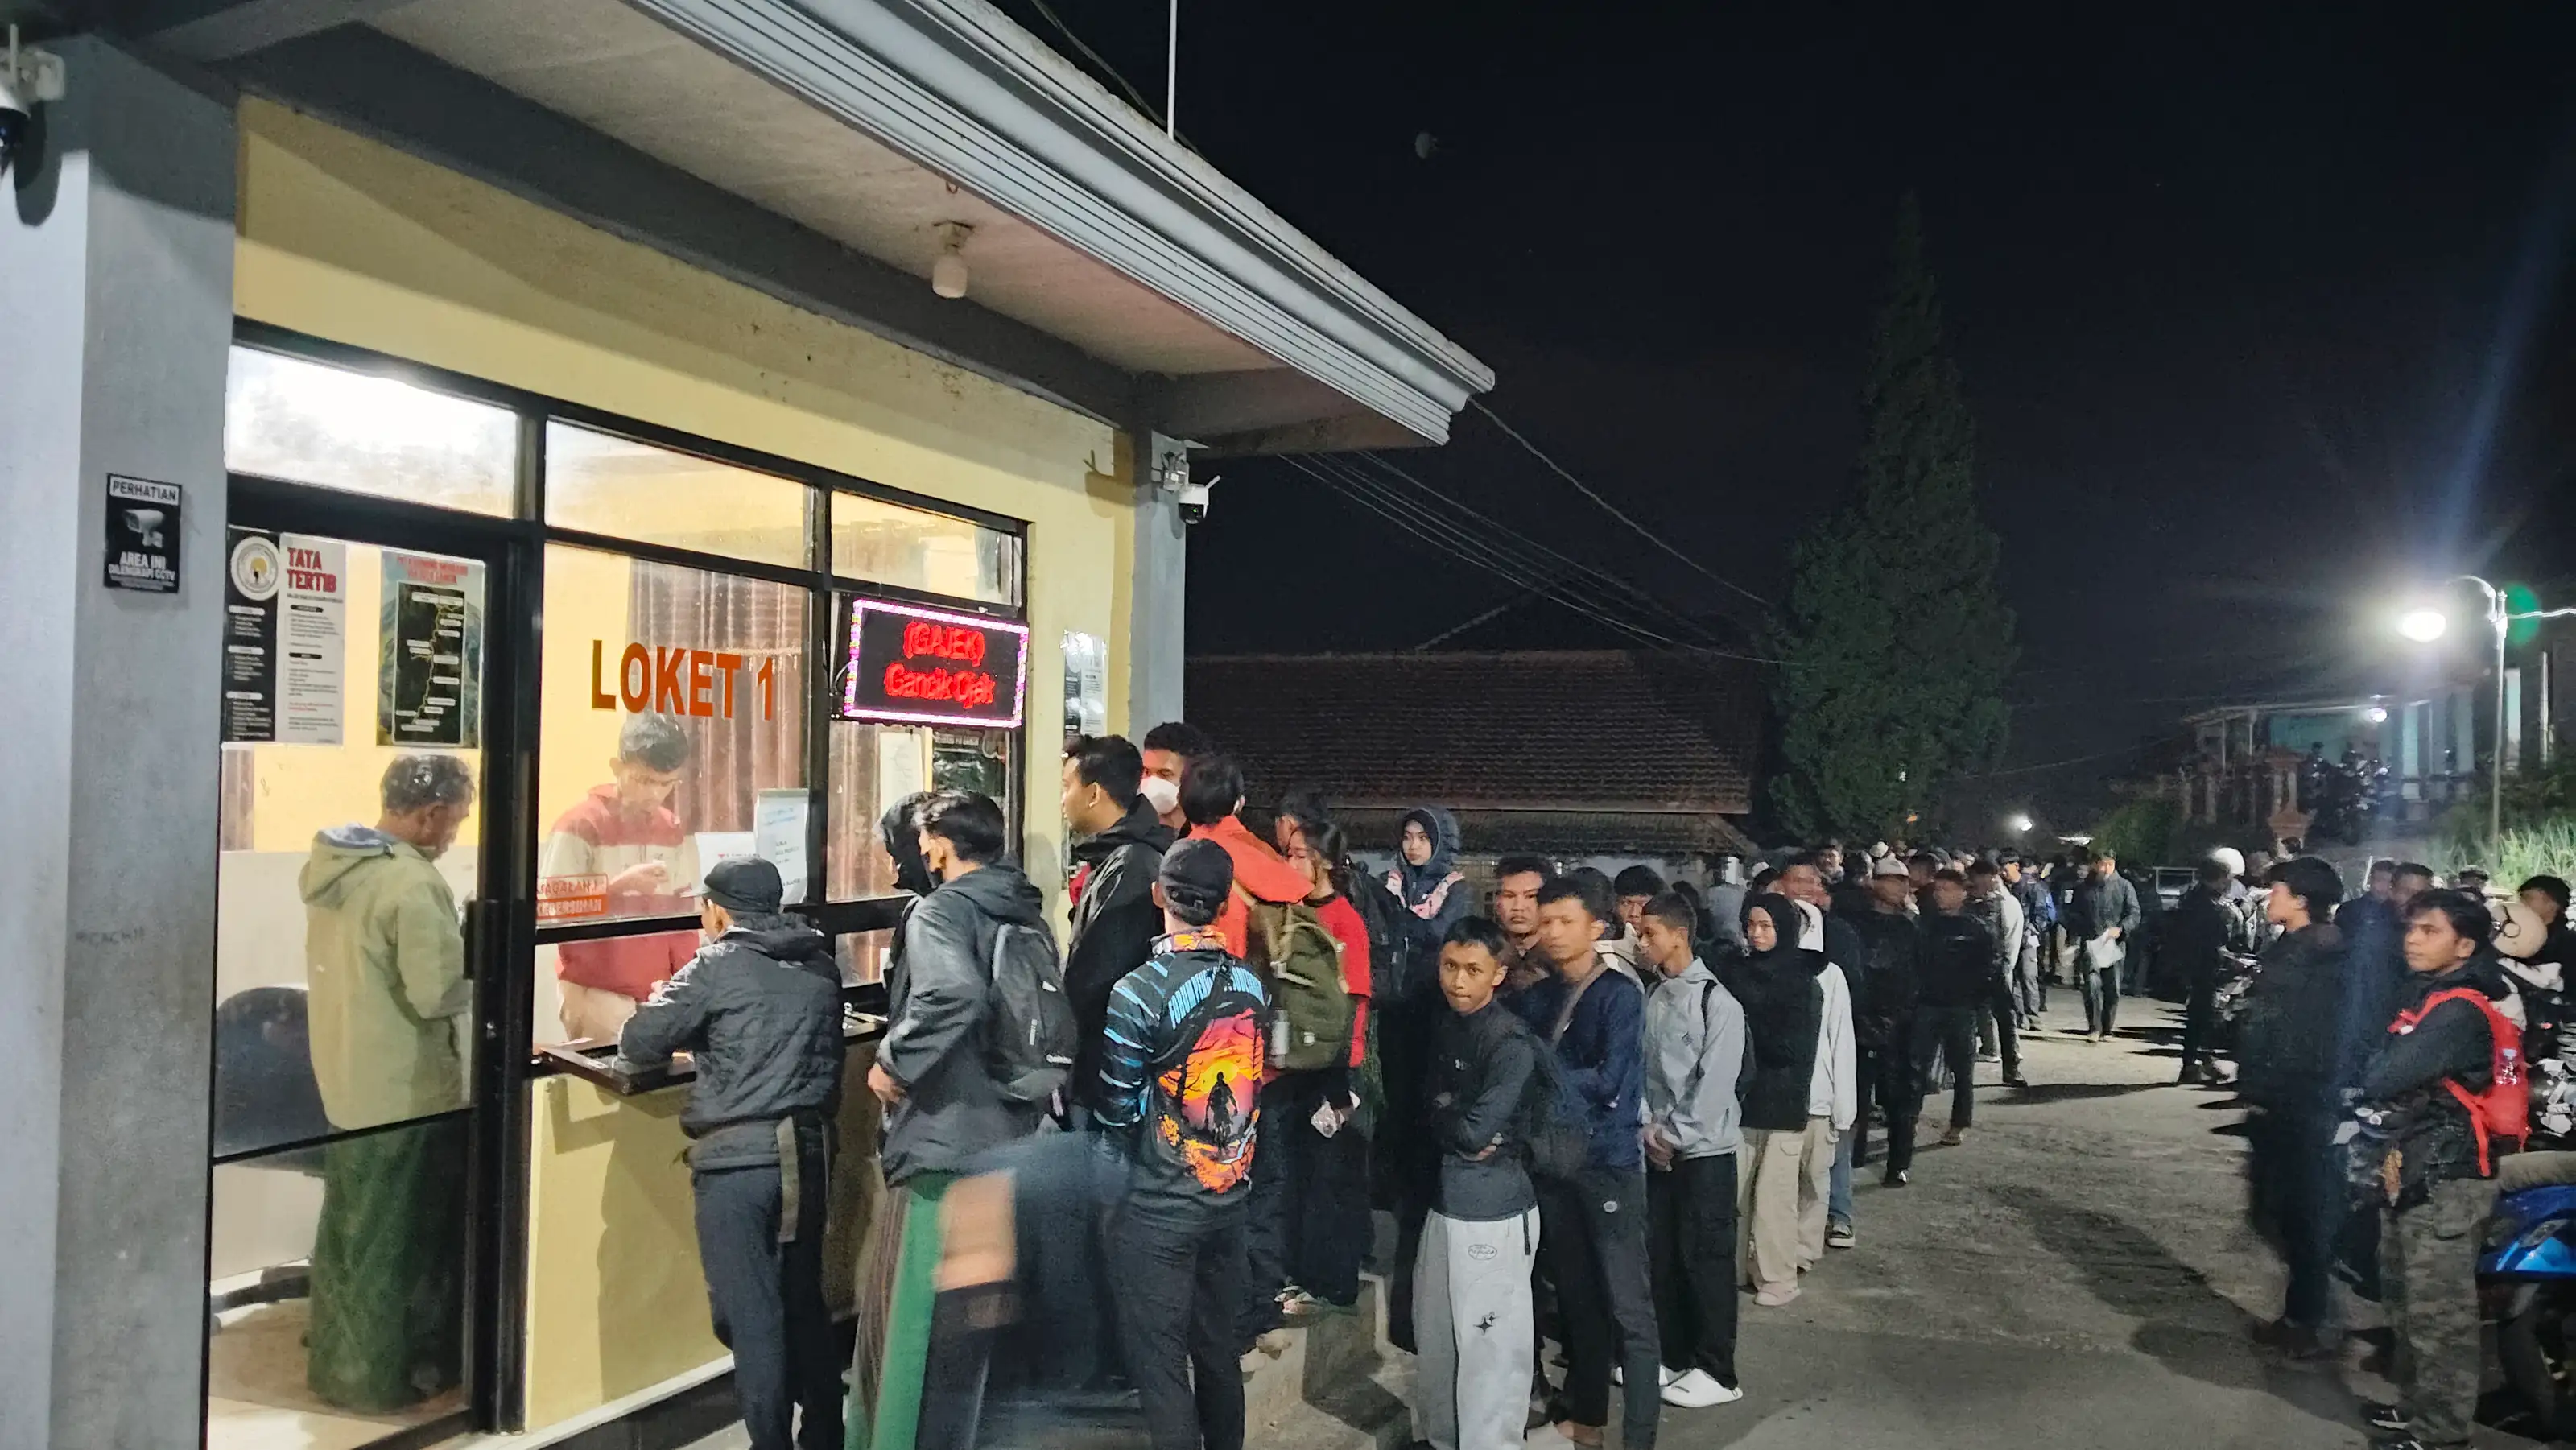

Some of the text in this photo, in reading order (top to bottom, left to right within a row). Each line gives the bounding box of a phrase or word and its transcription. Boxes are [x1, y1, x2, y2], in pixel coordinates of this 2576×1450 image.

[113, 480, 176, 501] PERHATIAN
[119, 551, 167, 570] AREA INI
[287, 547, 322, 570] TATA
[155, 568, 175, 581] CCTV
[286, 568, 336, 593] TERTIB
[591, 639, 774, 721] LOKET 1
